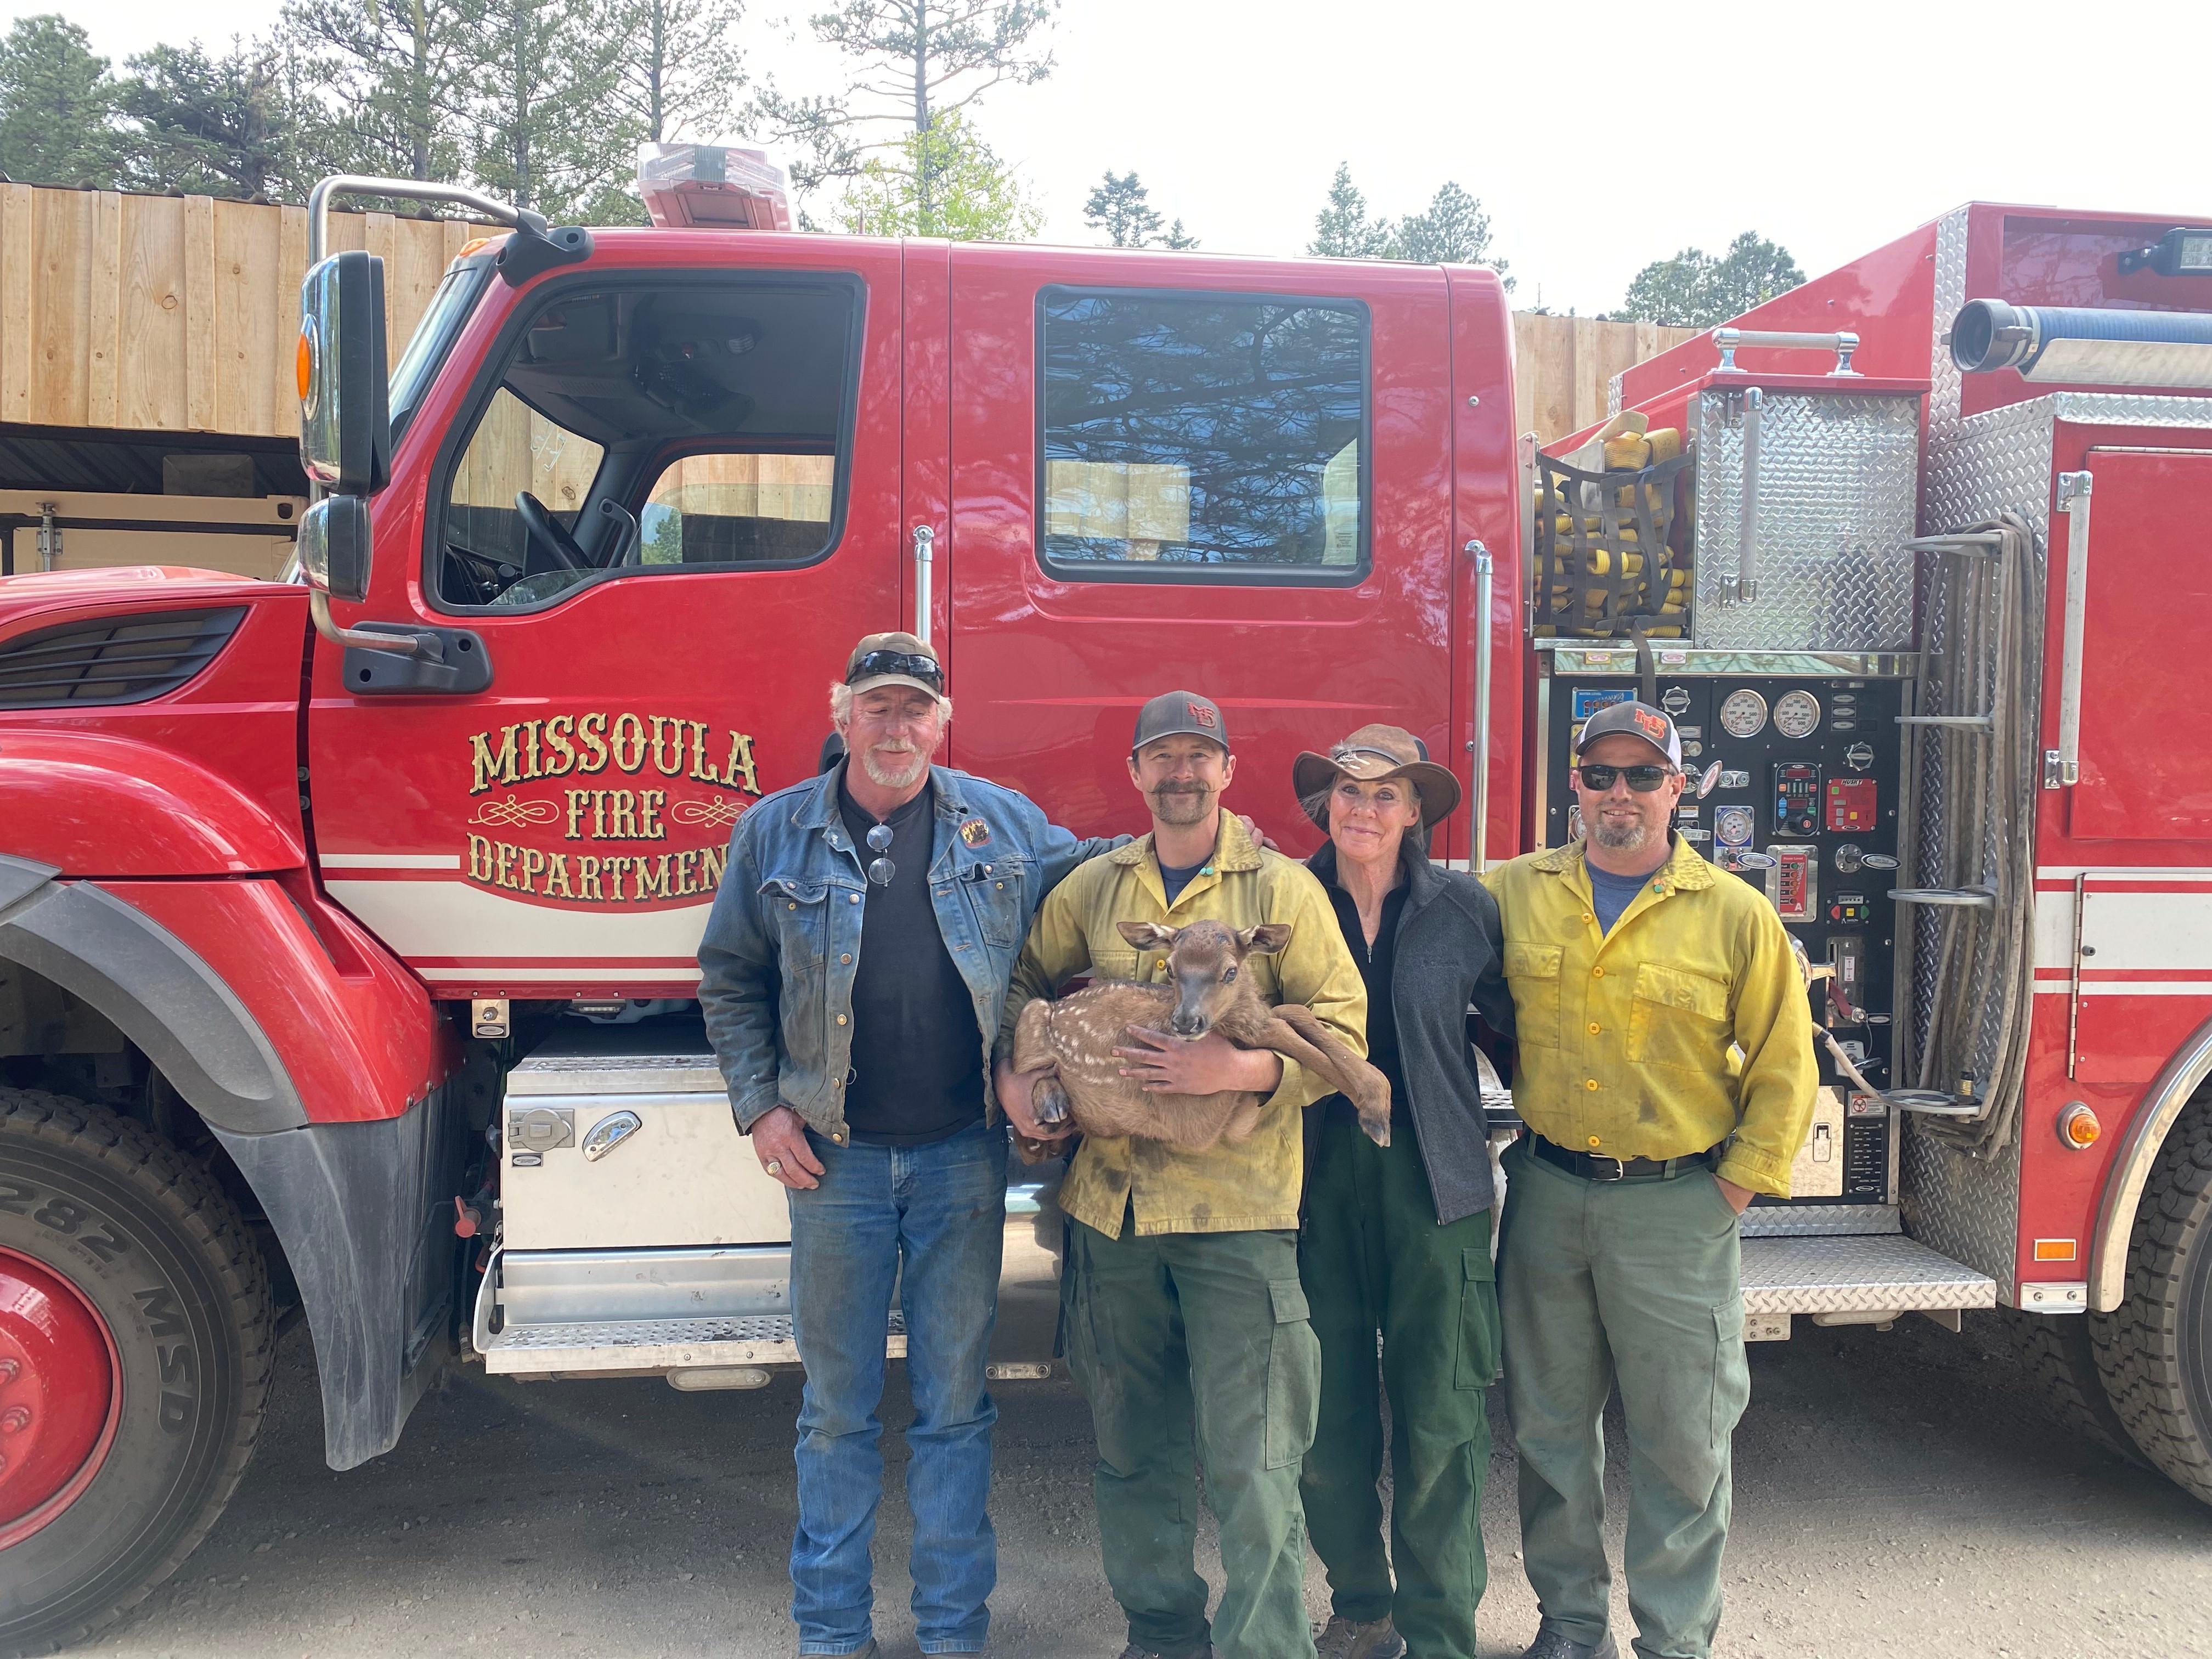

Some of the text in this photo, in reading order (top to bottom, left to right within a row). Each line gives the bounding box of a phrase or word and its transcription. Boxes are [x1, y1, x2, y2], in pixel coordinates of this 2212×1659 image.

[468, 712, 762, 795] MISSOULA
[564, 789, 667, 839] FIRE
[466, 832, 729, 901] DEPARTMEN
[1794, 902, 1803, 911] A
[132, 1285, 193, 1434] MSD
